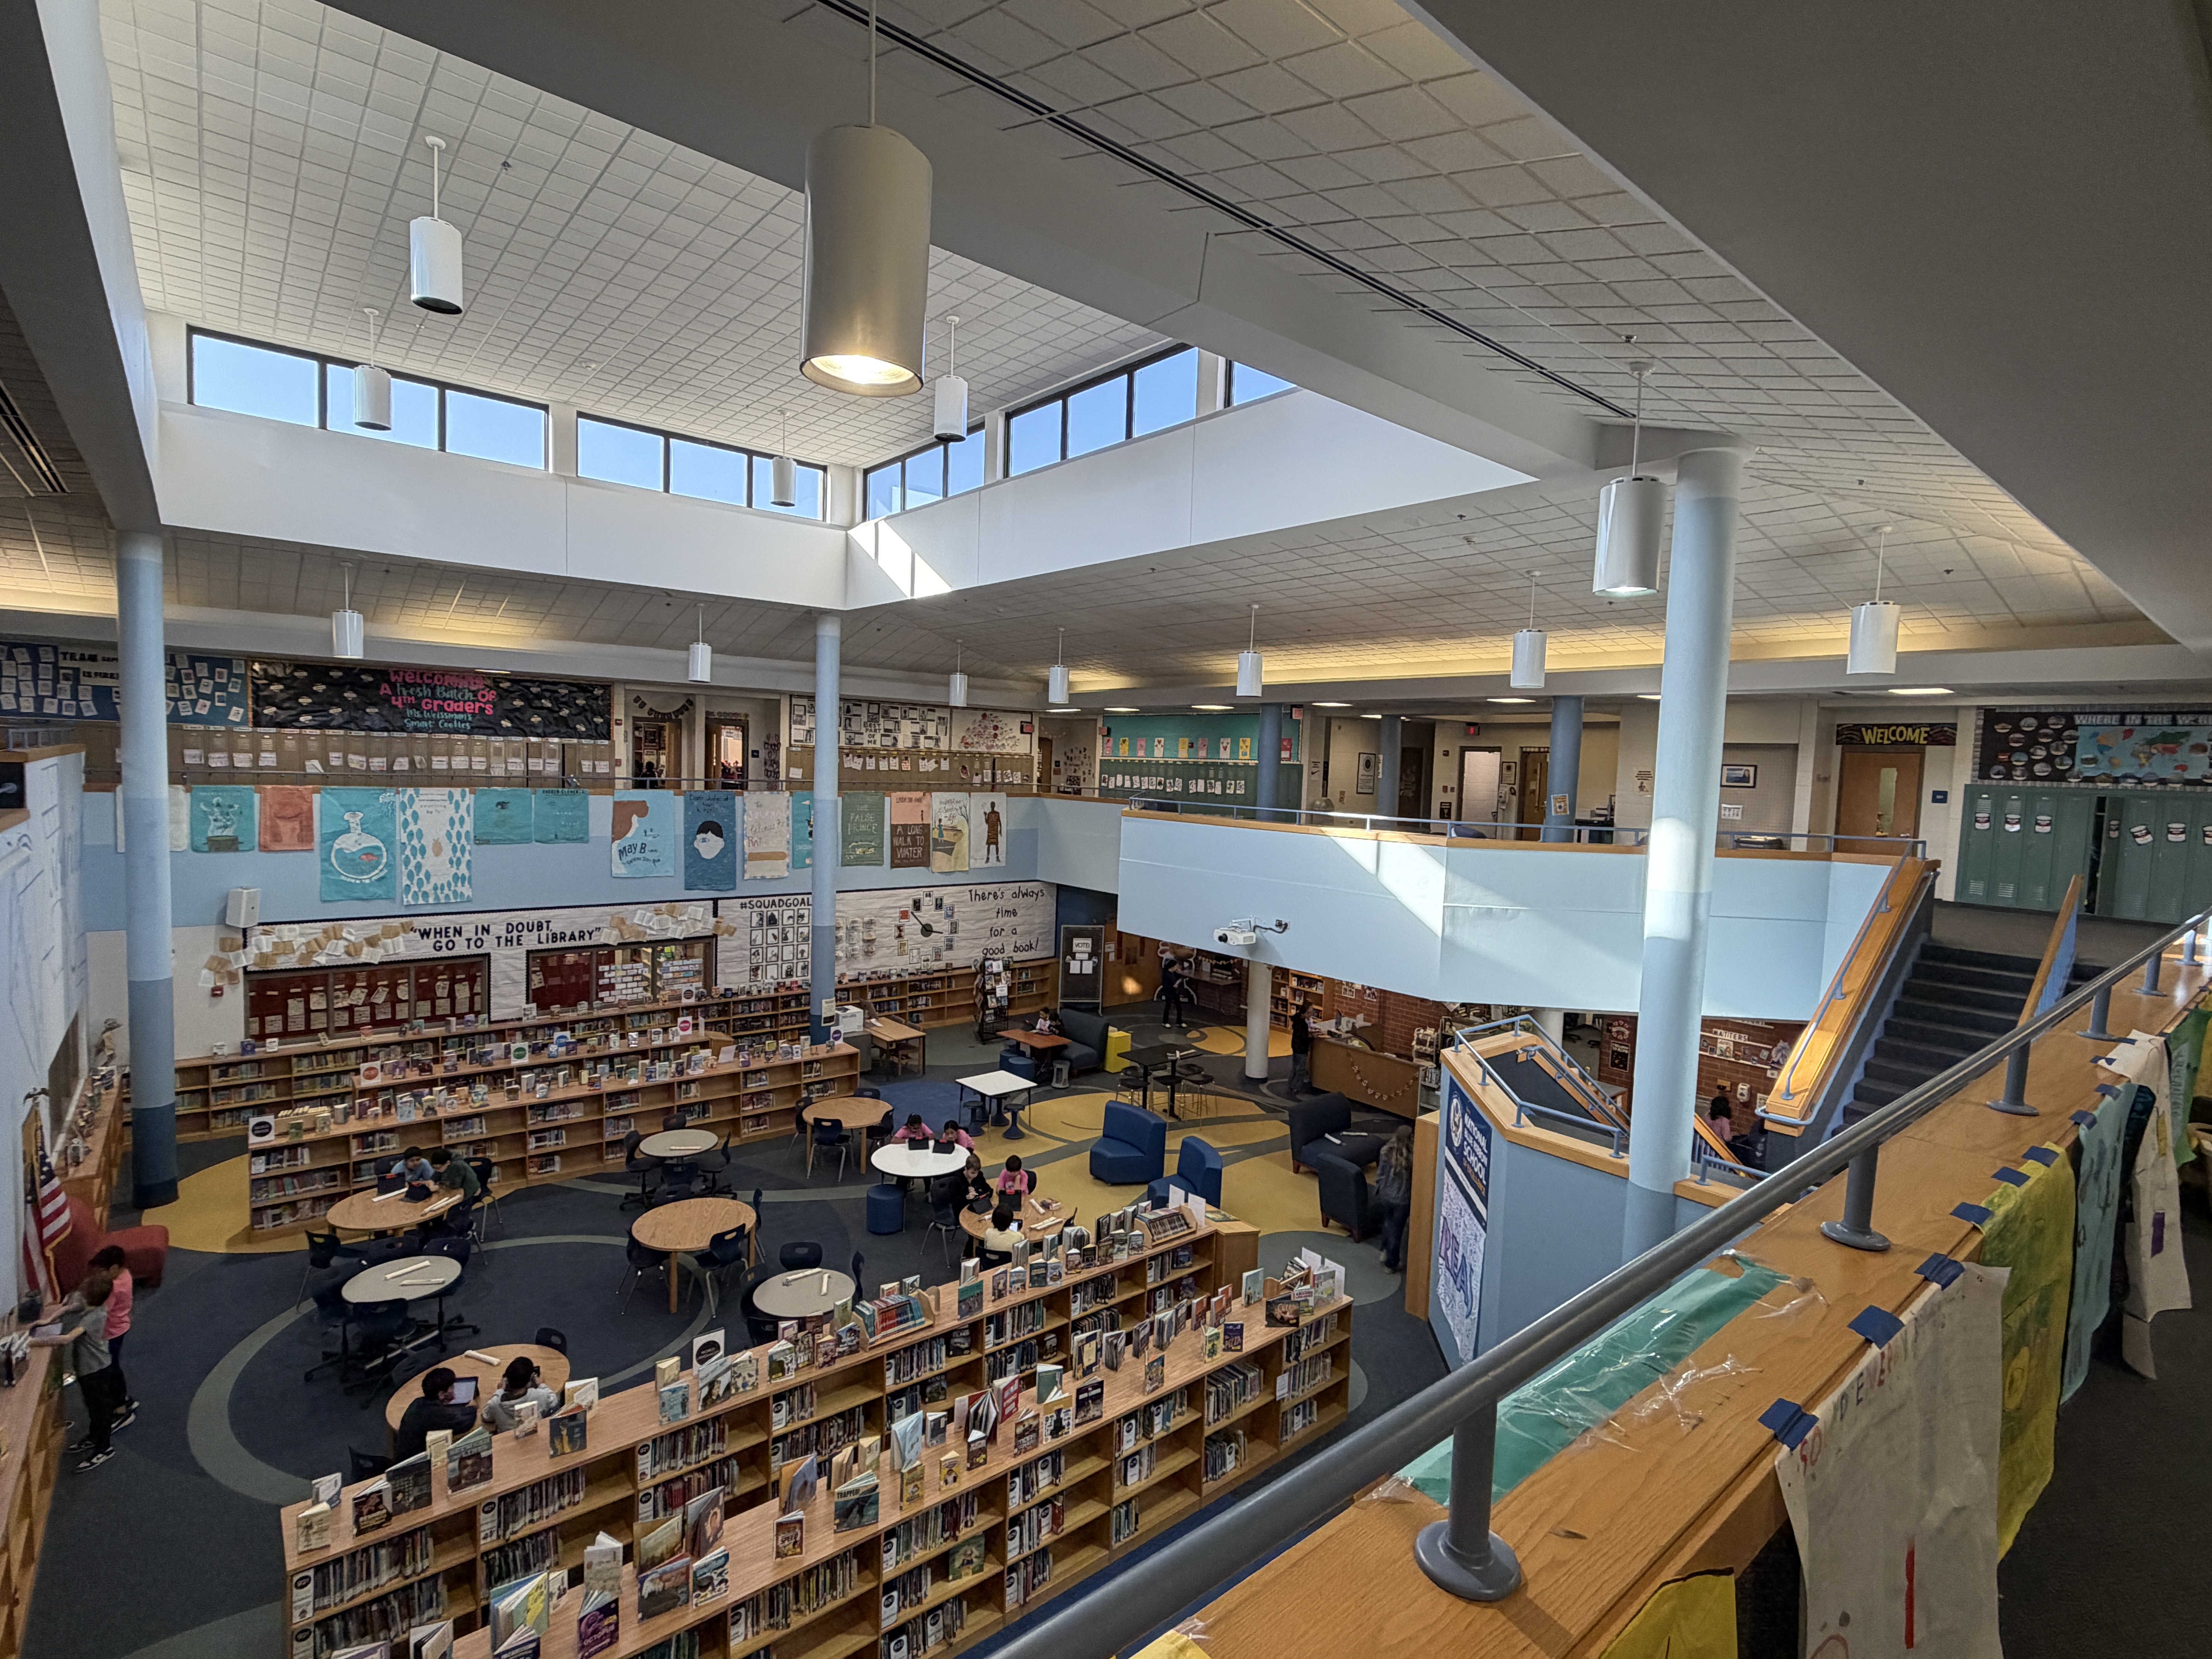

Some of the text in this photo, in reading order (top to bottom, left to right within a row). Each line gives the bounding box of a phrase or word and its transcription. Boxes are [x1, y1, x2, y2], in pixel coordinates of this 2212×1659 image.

[380, 683, 392, 695] A
[397, 683, 432, 697] Fresh
[422, 698, 494, 715] Graders
[2074, 714, 2121, 725] WHERE
[2125, 714, 2142, 725] IN
[1861, 726, 1930, 744] WELCOME
[848, 823, 878, 835] PRINCE
[896, 825, 923, 835] A LONG
[893, 836, 925, 846] WALK TO
[618, 843, 638, 861] May
[896, 847, 923, 859] WATER
[968, 886, 1044, 902] There's always
[996, 907, 1018, 919] time
[410, 920, 553, 940] “WHEN IN DOUBT,
[990, 927, 1005, 938] for
[433, 927, 601, 951] GO TO THE LIBRARY”
[982, 937, 1039, 958] good book!
[1464, 1111, 1488, 1155] NATIONAL
[1473, 1139, 1488, 1169] RIBBON
[1463, 1138, 1487, 1187] SCHOOL
